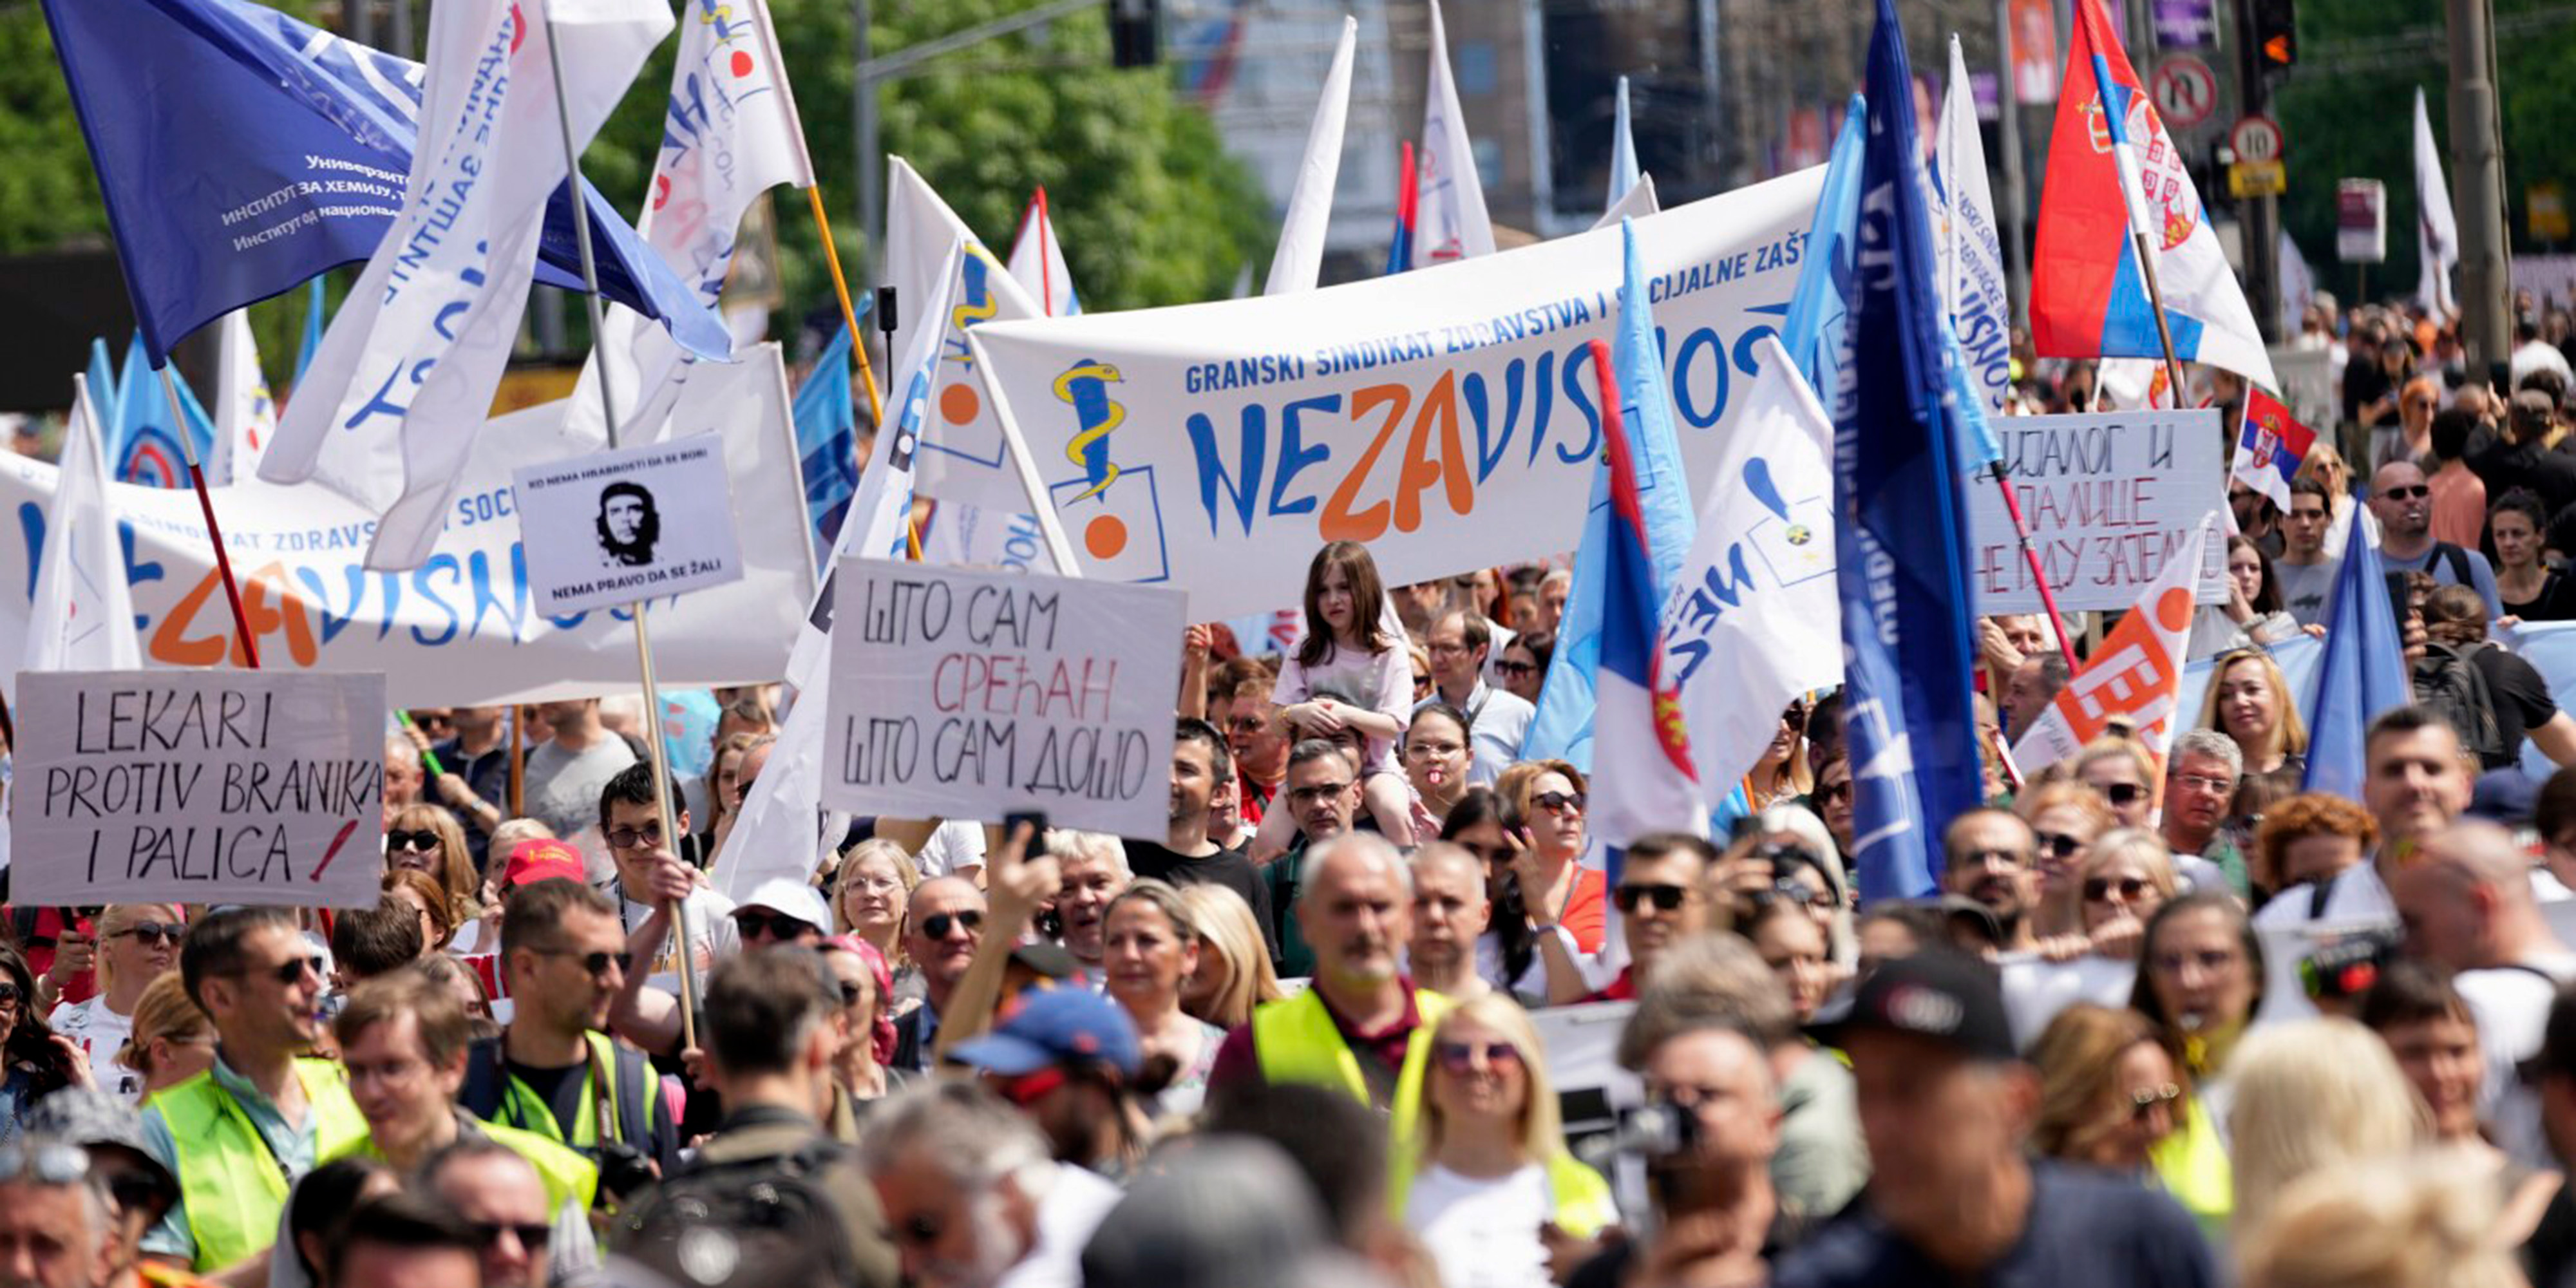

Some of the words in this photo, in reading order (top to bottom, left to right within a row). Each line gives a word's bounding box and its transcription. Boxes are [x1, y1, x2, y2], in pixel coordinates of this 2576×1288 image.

[305, 155, 410, 185] Универзит
[222, 184, 296, 227] ИНСТИТУТ
[298, 181, 322, 195] ЗА
[232, 216, 302, 252] Институт
[302, 209, 319, 226] од
[319, 205, 401, 218] национал
[1186, 354, 1305, 394] GRANSKI
[1315, 330, 1435, 377] SINDIKAT
[1441, 296, 1591, 354] ZDRAVSTVA
[1597, 290, 1606, 319] I
[1615, 252, 1749, 314] CIJALNE
[547, 473, 579, 486] NEMA
[1975, 424, 2125, 484] ИЈАЛОГ
[2148, 424, 2174, 469] И
[2017, 477, 2159, 532] ПАЛИЦЕ
[274, 520, 379, 552] ZDRAVS
[551, 582, 594, 601] NEMA
[597, 574, 646, 592] PRAVO
[648, 569, 668, 583] DA
[670, 565, 687, 579] SE
[690, 559, 722, 575] ŽALI
[864, 579, 952, 646] ШТО
[967, 585, 1060, 650] САМ
[933, 652, 1117, 723] СРЕЋАН
[75, 690, 273, 755] LEKARI
[844, 714, 920, 786] ШТО
[933, 717, 1016, 788] САМ
[1025, 725, 1150, 802] ДОШО
[44, 762, 202, 818] PROTIV
[220, 759, 384, 817] BRANIKA
[87, 829, 100, 883] I
